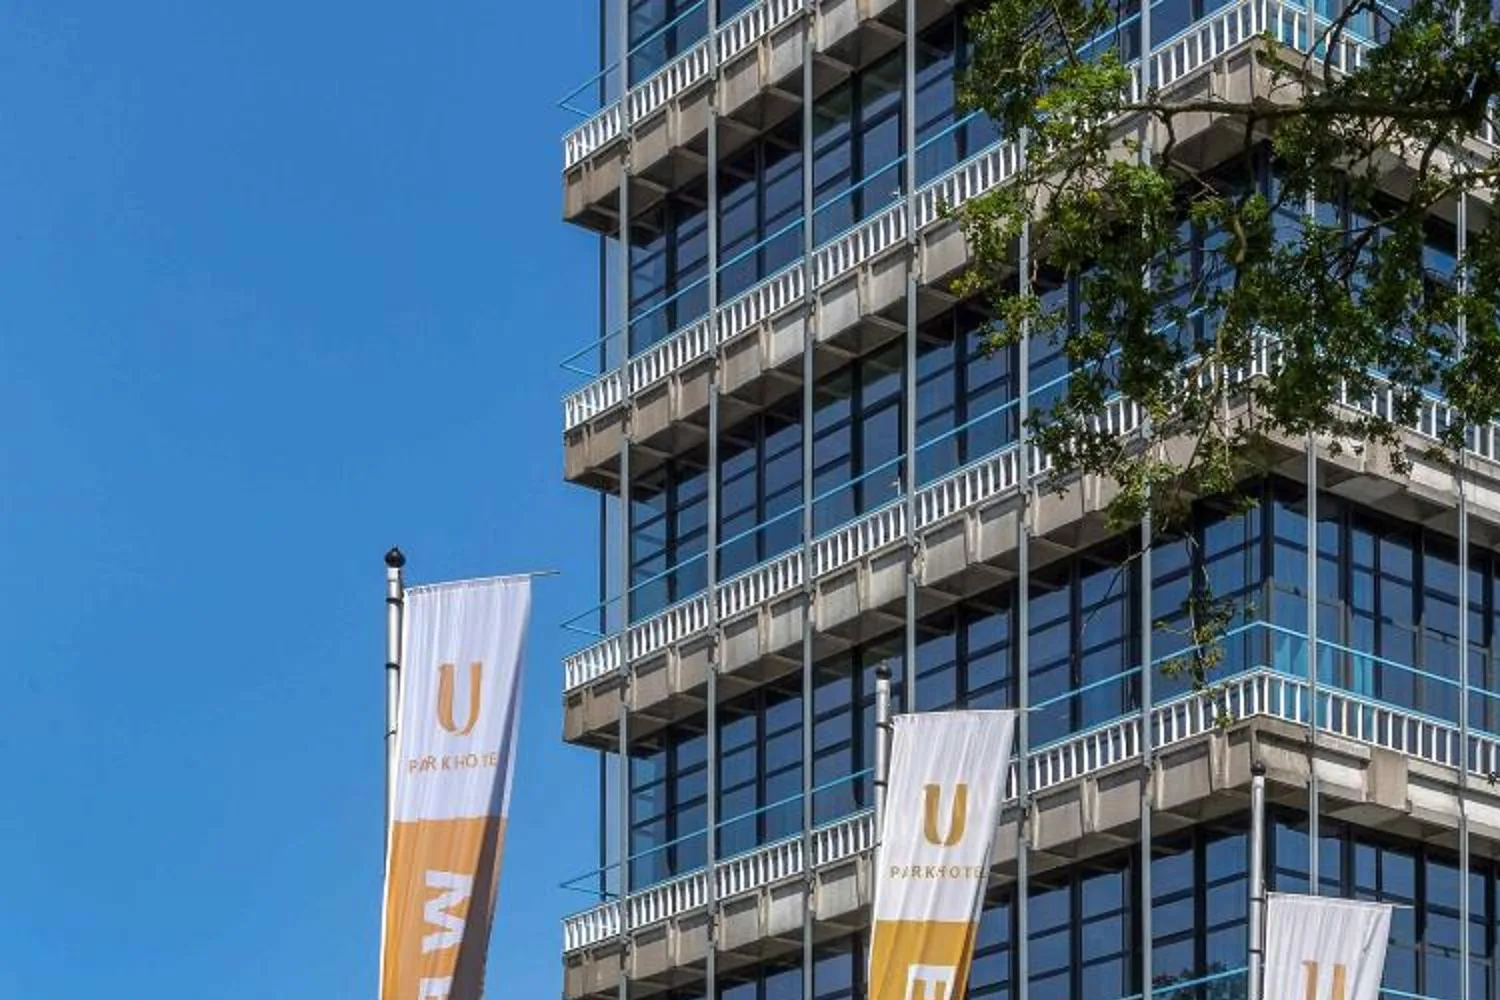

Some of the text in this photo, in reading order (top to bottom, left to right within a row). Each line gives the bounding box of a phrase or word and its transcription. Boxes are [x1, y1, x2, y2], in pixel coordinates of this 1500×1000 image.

[436, 661, 483, 737] U
[408, 752, 498, 773] PARKHOTE
[922, 781, 970, 848] U
